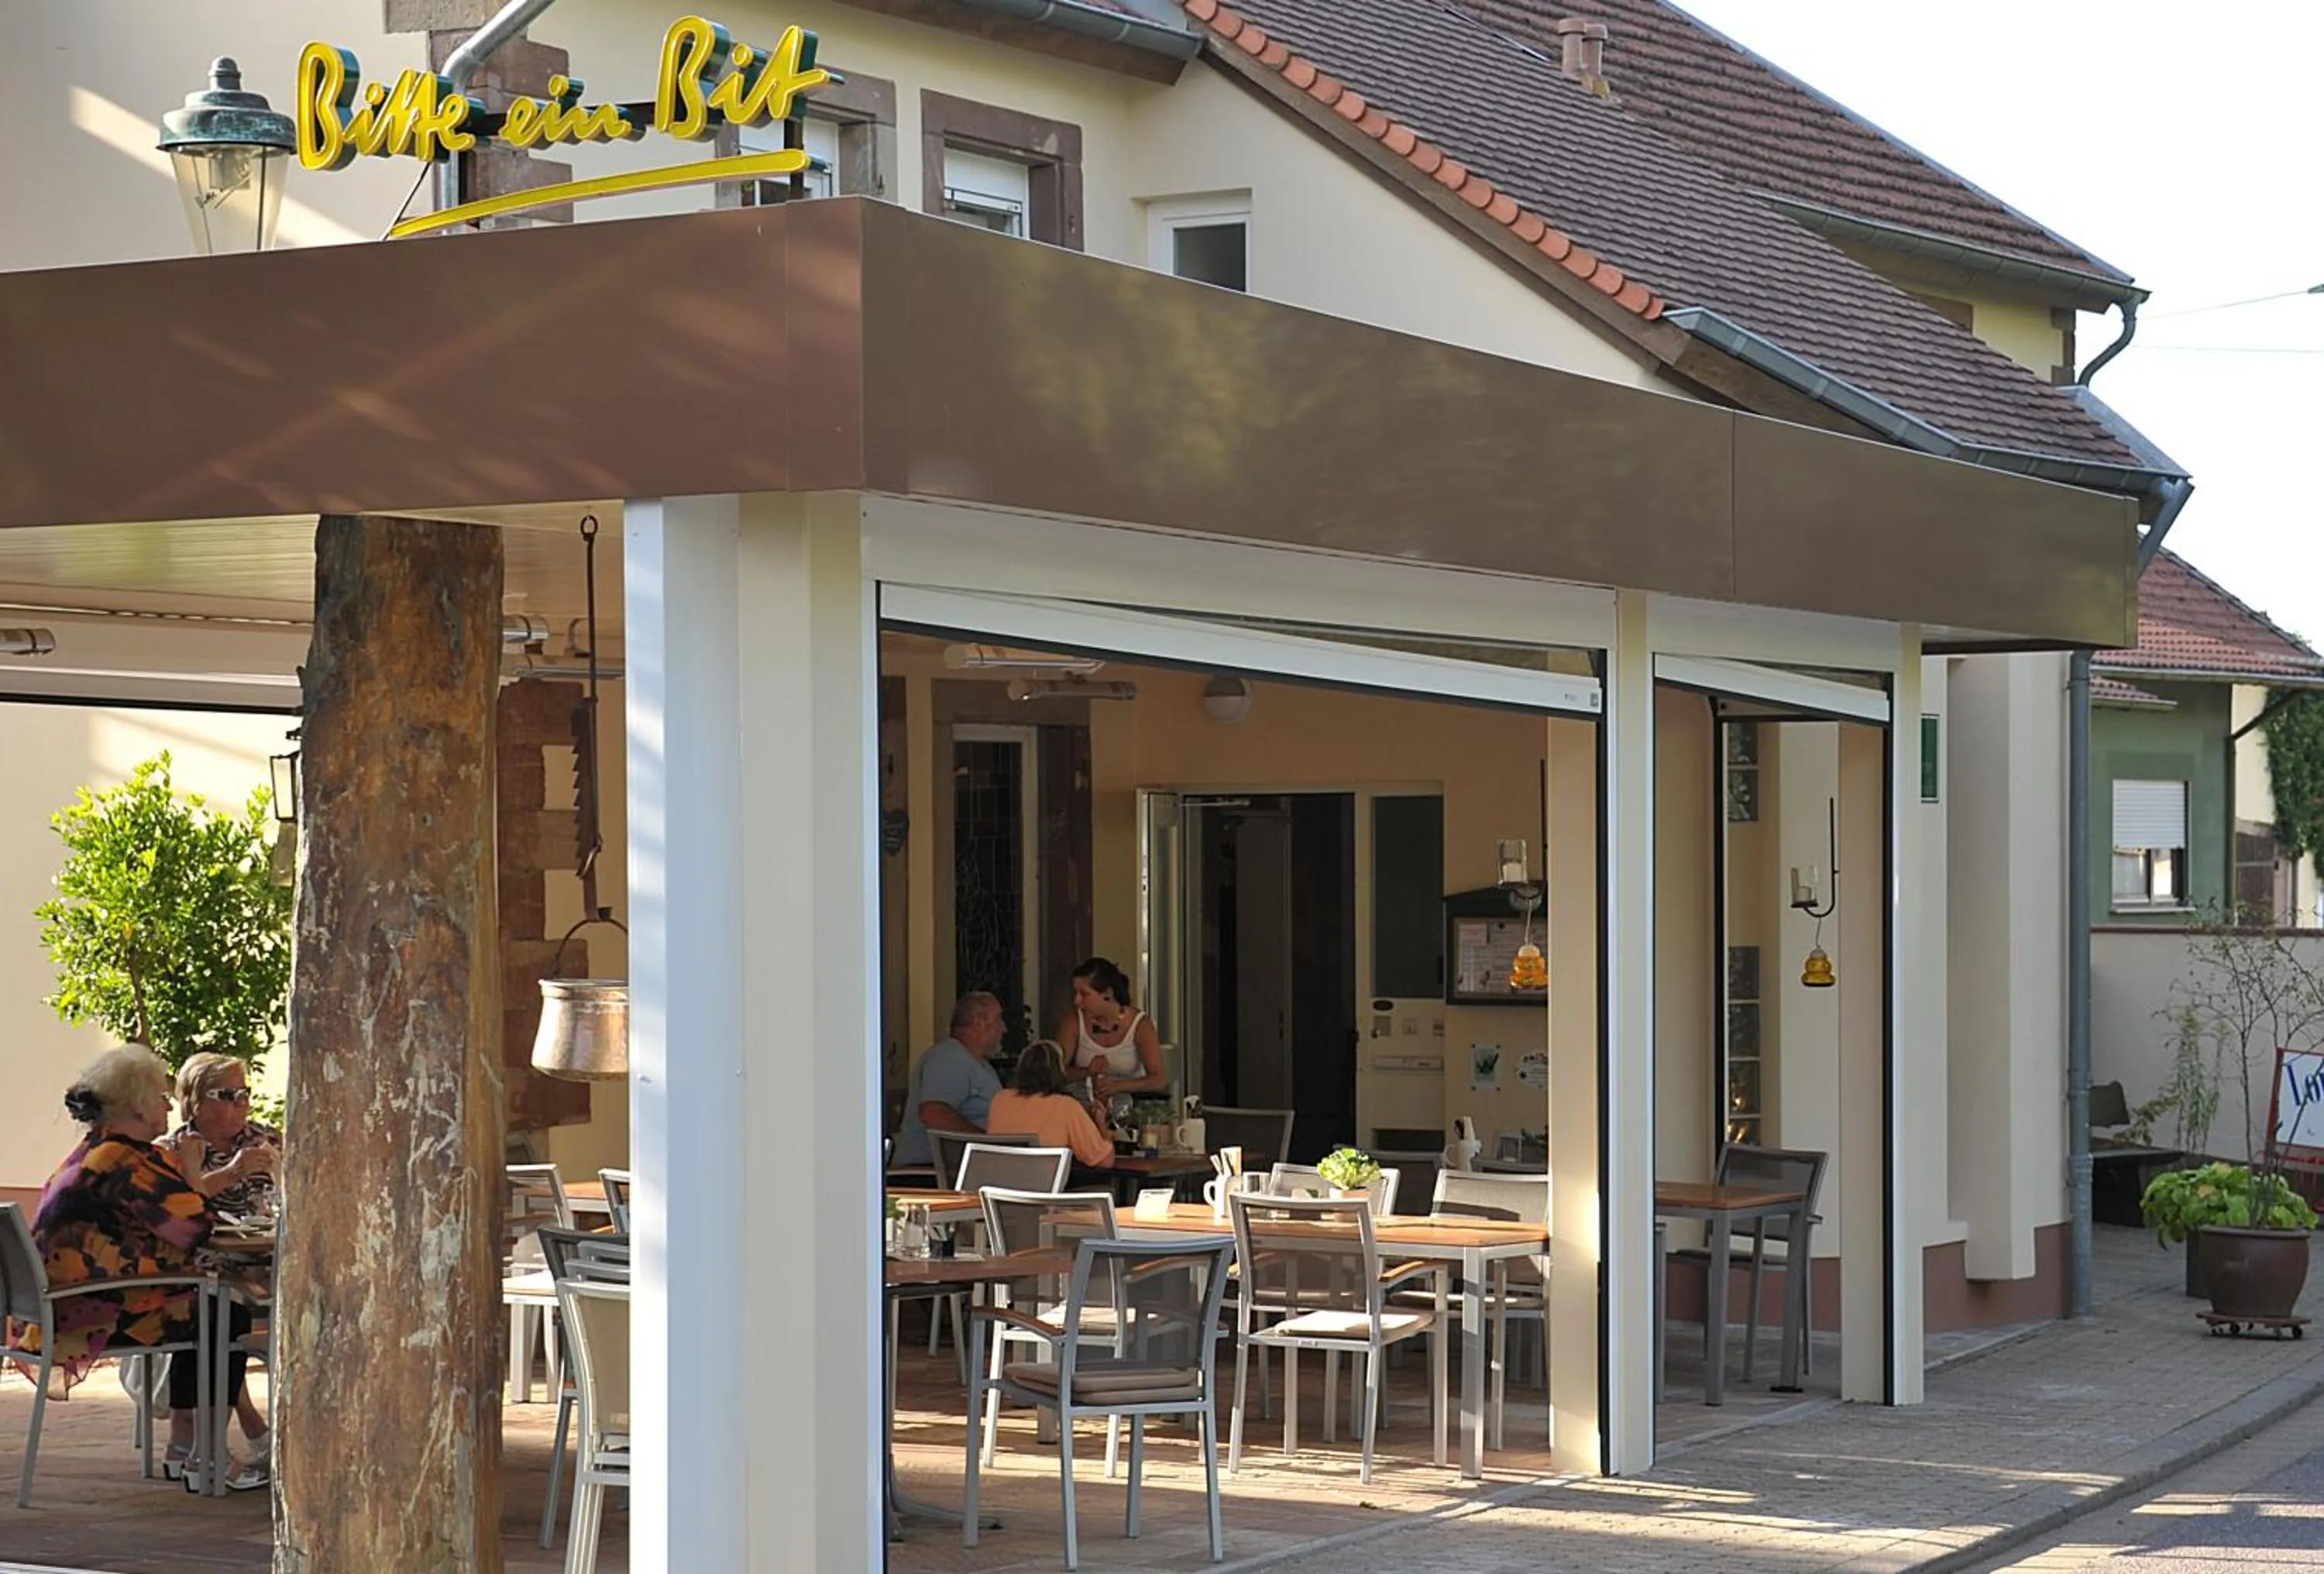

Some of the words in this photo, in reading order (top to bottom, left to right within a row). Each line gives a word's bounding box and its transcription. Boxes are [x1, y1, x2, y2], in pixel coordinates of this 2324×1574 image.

[296, 40, 480, 170] Bitte
[500, 74, 637, 149] ein
[654, 15, 835, 140] Bit
